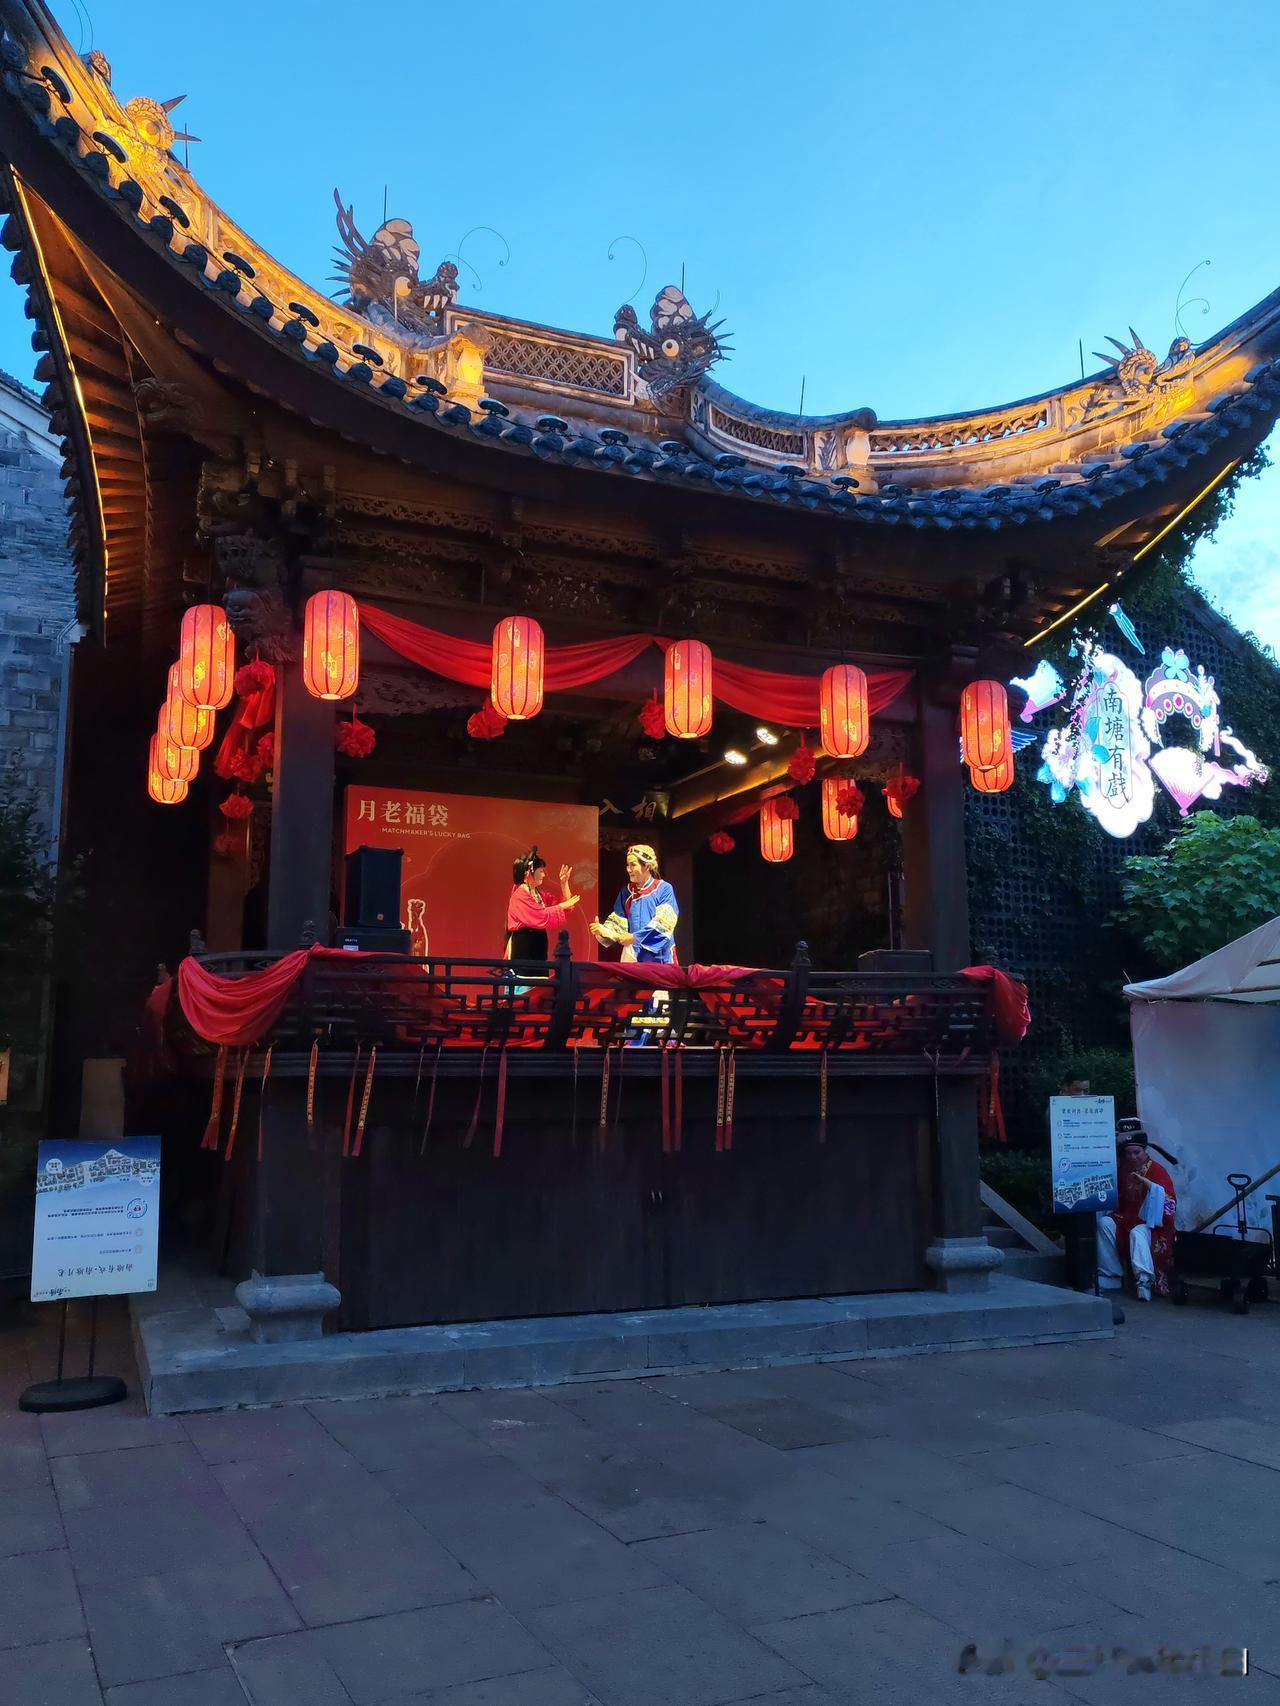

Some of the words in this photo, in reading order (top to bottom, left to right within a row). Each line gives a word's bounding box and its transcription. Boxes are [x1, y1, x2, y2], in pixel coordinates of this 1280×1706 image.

[357, 799, 449, 826] 月老福袋
[381, 827, 434, 837] MATCHMAKER'S
[434, 830, 456, 839] LUCKY
